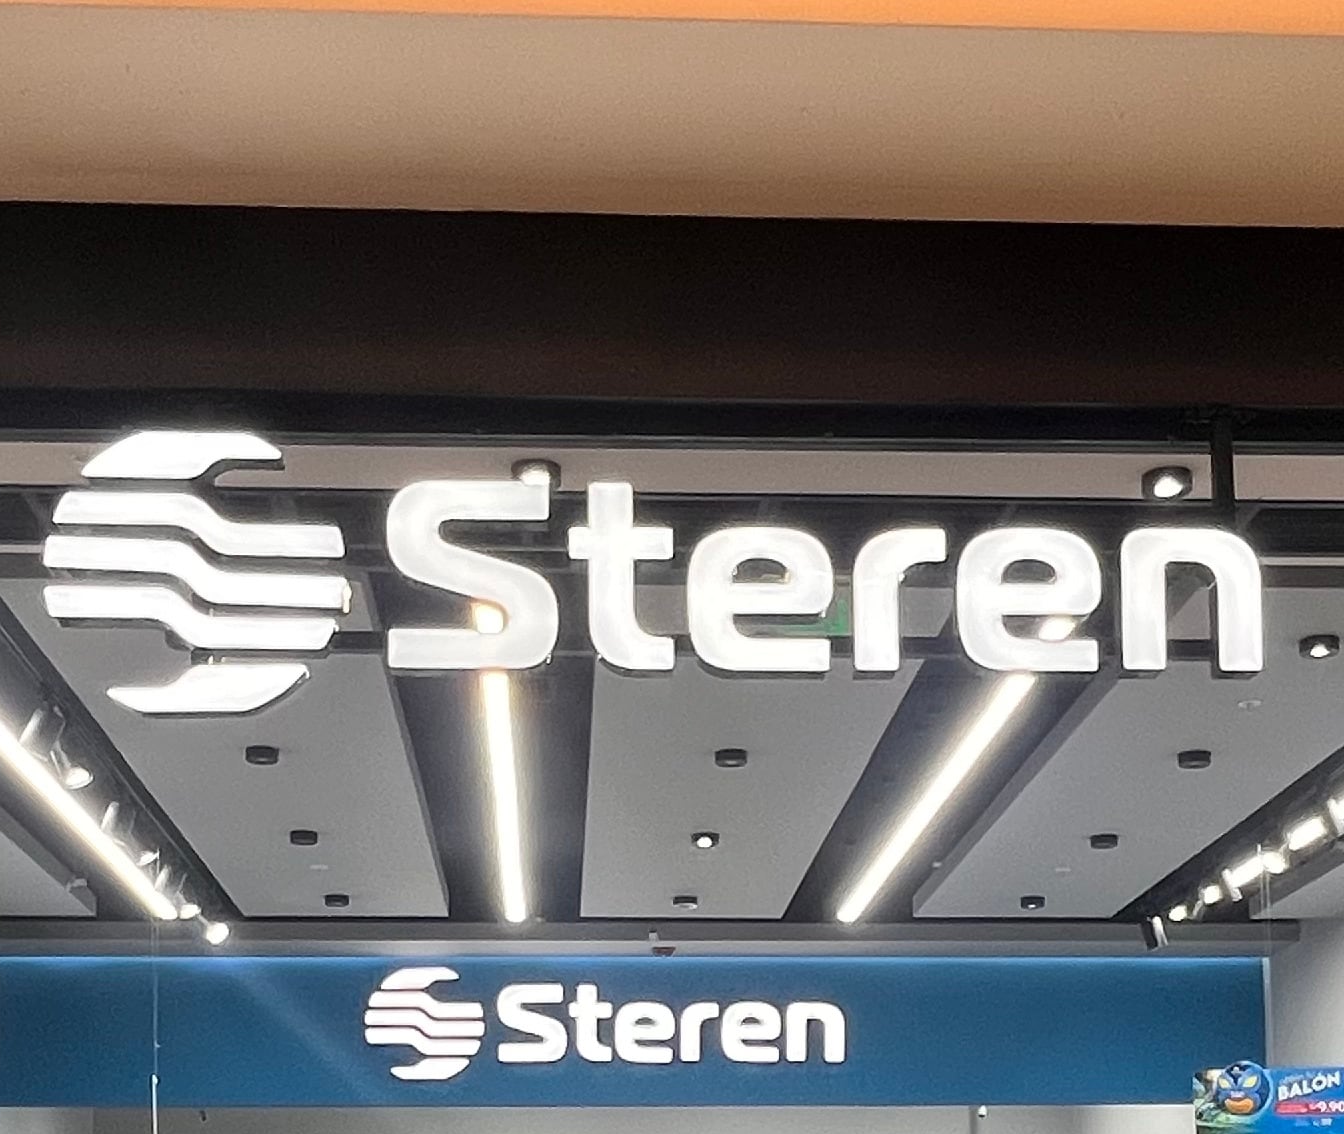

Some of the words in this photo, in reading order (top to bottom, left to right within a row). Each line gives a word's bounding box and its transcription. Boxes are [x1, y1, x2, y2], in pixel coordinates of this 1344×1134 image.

[385, 480, 1266, 676] Steren
[496, 982, 846, 1067] Steren
[1277, 1070, 1342, 1101] BALÓN
